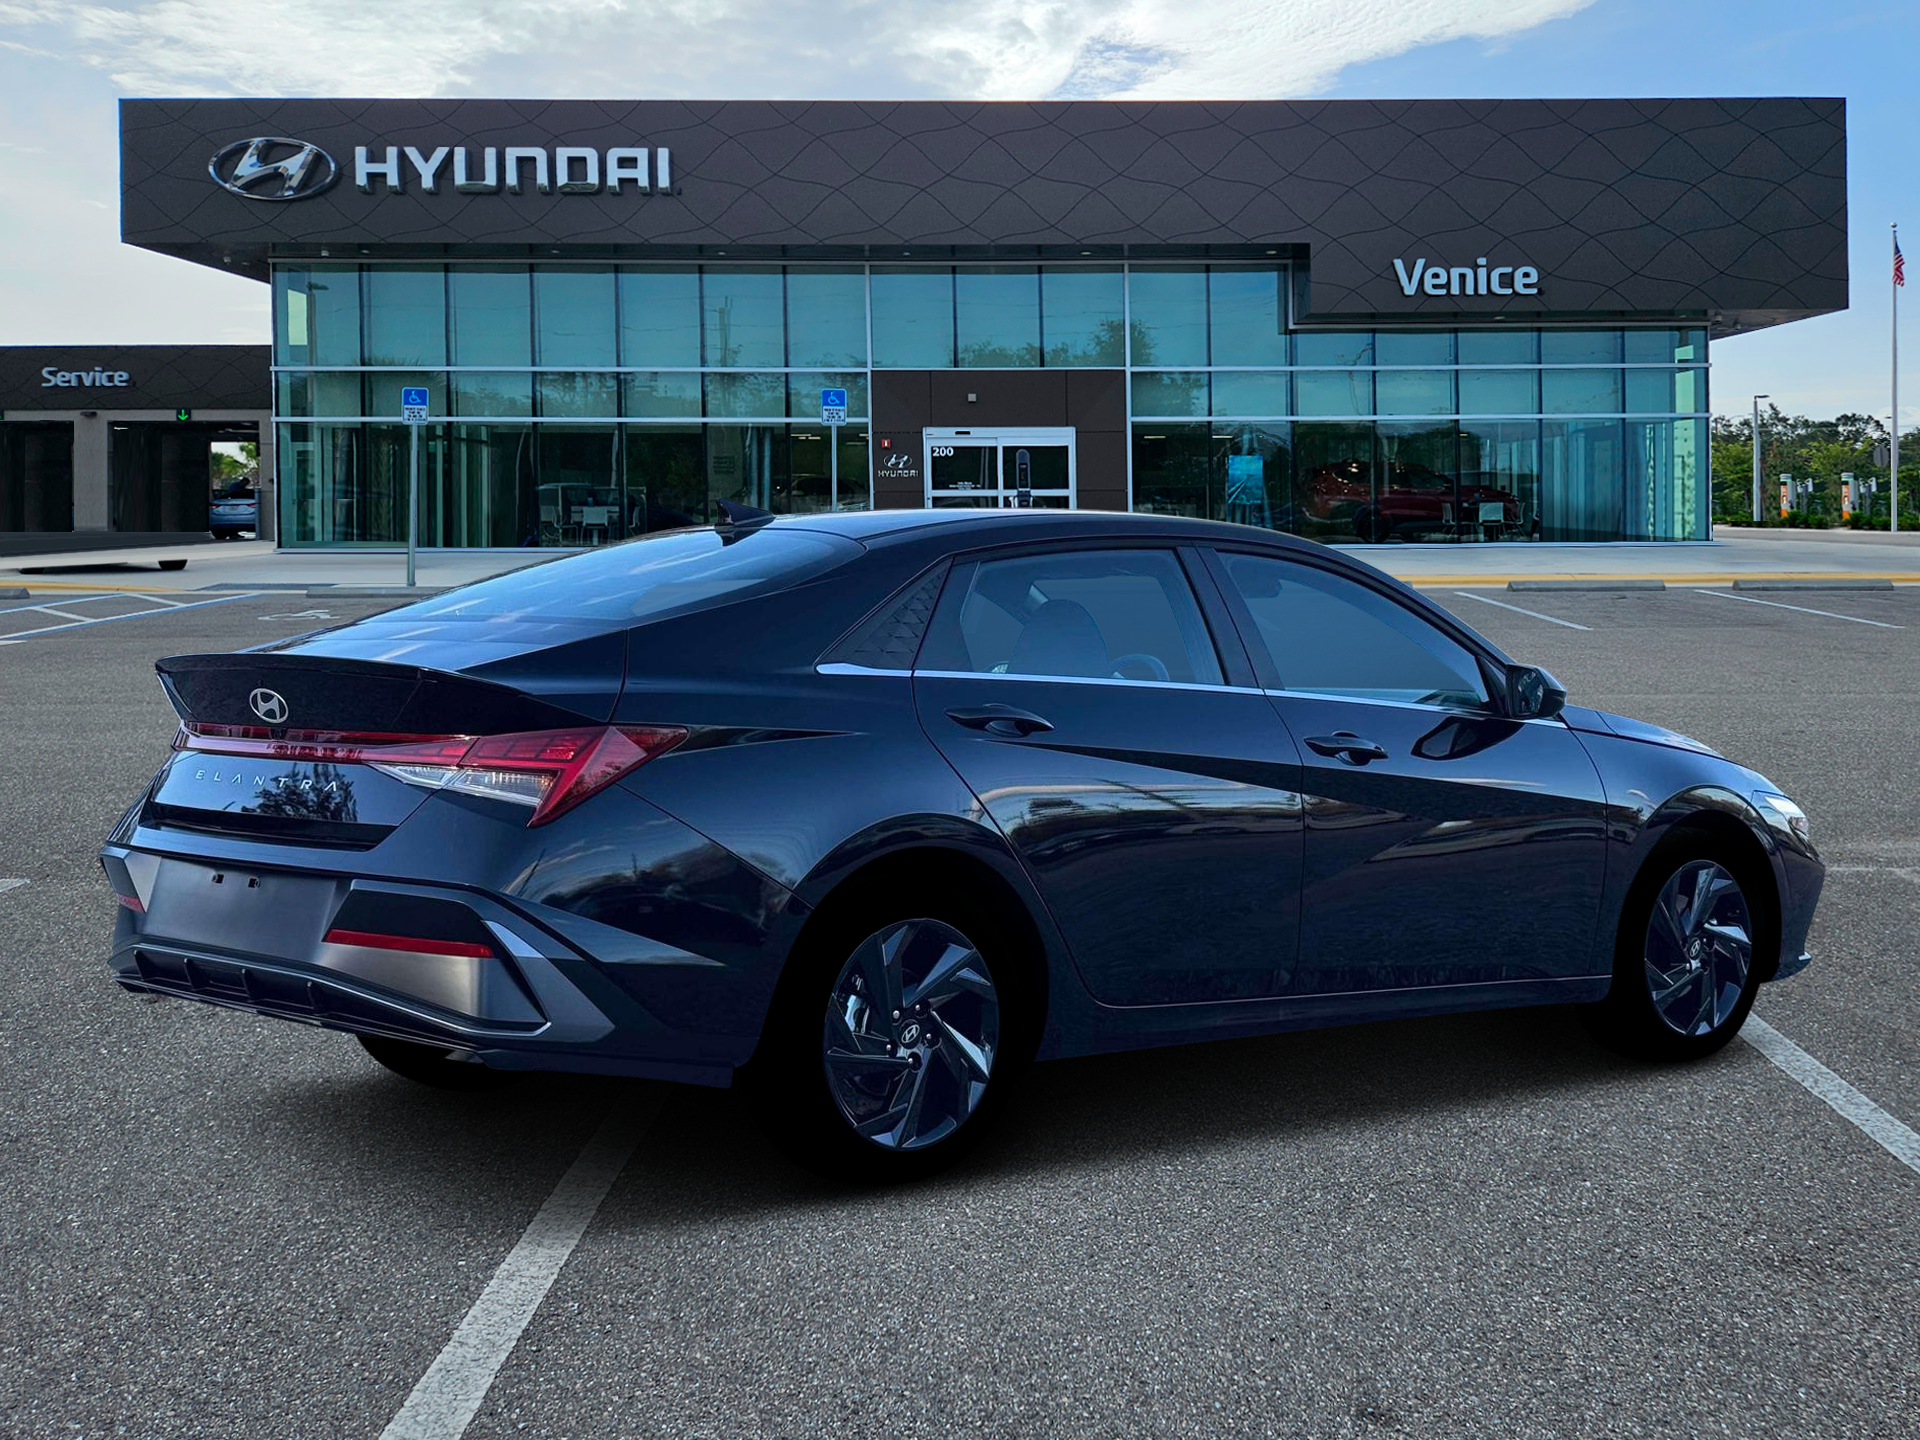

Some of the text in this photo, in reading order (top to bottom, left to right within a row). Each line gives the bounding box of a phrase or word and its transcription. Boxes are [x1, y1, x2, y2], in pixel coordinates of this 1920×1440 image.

[355, 146, 670, 193] HYUNDAI
[1393, 257, 1539, 296] Venice
[41, 366, 130, 387] Service
[932, 446, 954, 457] 200
[877, 469, 919, 478] HYUNDAI
[196, 769, 337, 792] ELANTRA
